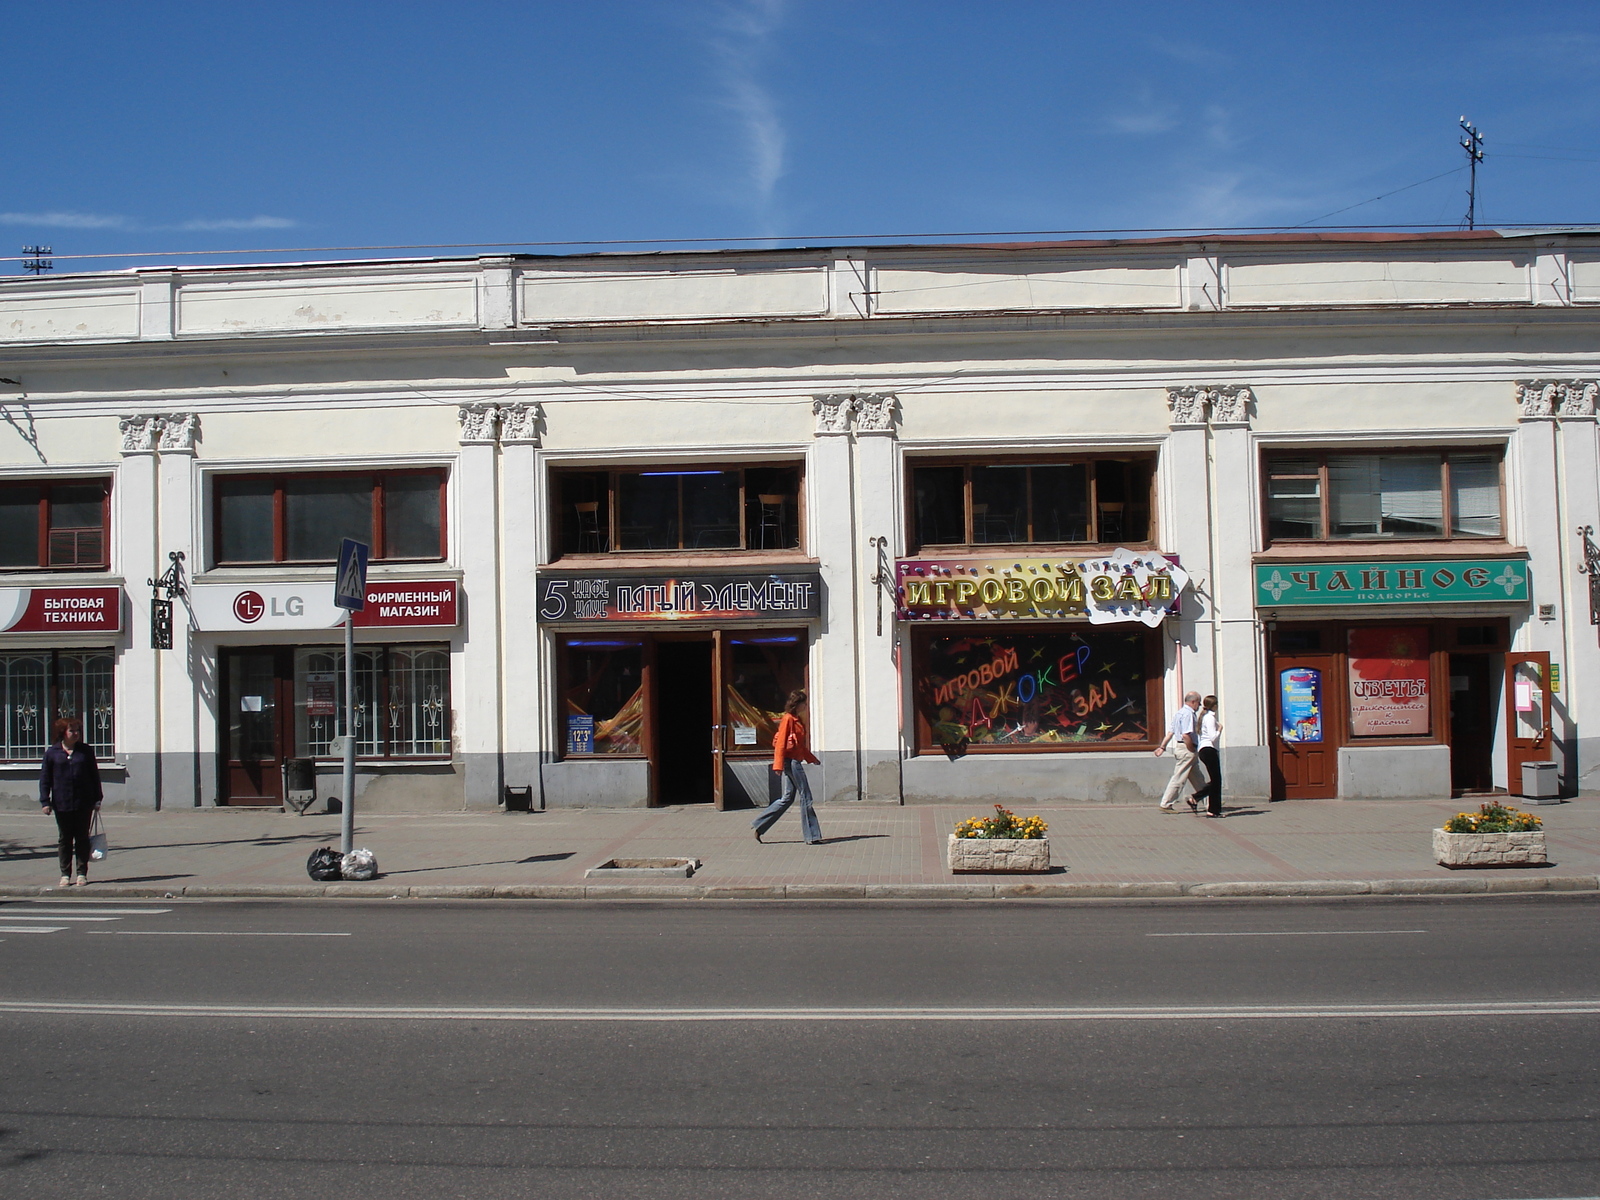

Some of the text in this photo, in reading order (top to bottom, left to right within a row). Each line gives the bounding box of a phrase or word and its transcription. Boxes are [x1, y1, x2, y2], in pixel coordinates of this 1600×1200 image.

[572, 579, 609, 599] КАФЕ
[908, 568, 1172, 605] ИГРОВОЙ ЗАЛ
[1290, 567, 1491, 592] ЧАЙНОЕ
[44, 598, 104, 609] БЫТОВАЯ
[271, 595, 304, 617] LG
[367, 589, 452, 604] ФИРМЕННЫЙ
[540, 580, 812, 620] 5 ПЯТЫЙ ЭЛЕМЕНТ
[43, 611, 105, 622] ТЕХНИКА
[379, 605, 439, 617] МАГАЗИН
[573, 599, 608, 619] КЛУБ
[934, 647, 1020, 705] ИГРОВОЙ
[969, 645, 1091, 738] ДЖОКЕР
[1073, 680, 1117, 717] ЗАЛ
[1353, 679, 1427, 701] ЦВЕТЫ
[1352, 703, 1425, 716] прикоснитесь
[1367, 719, 1411, 731] красоте
